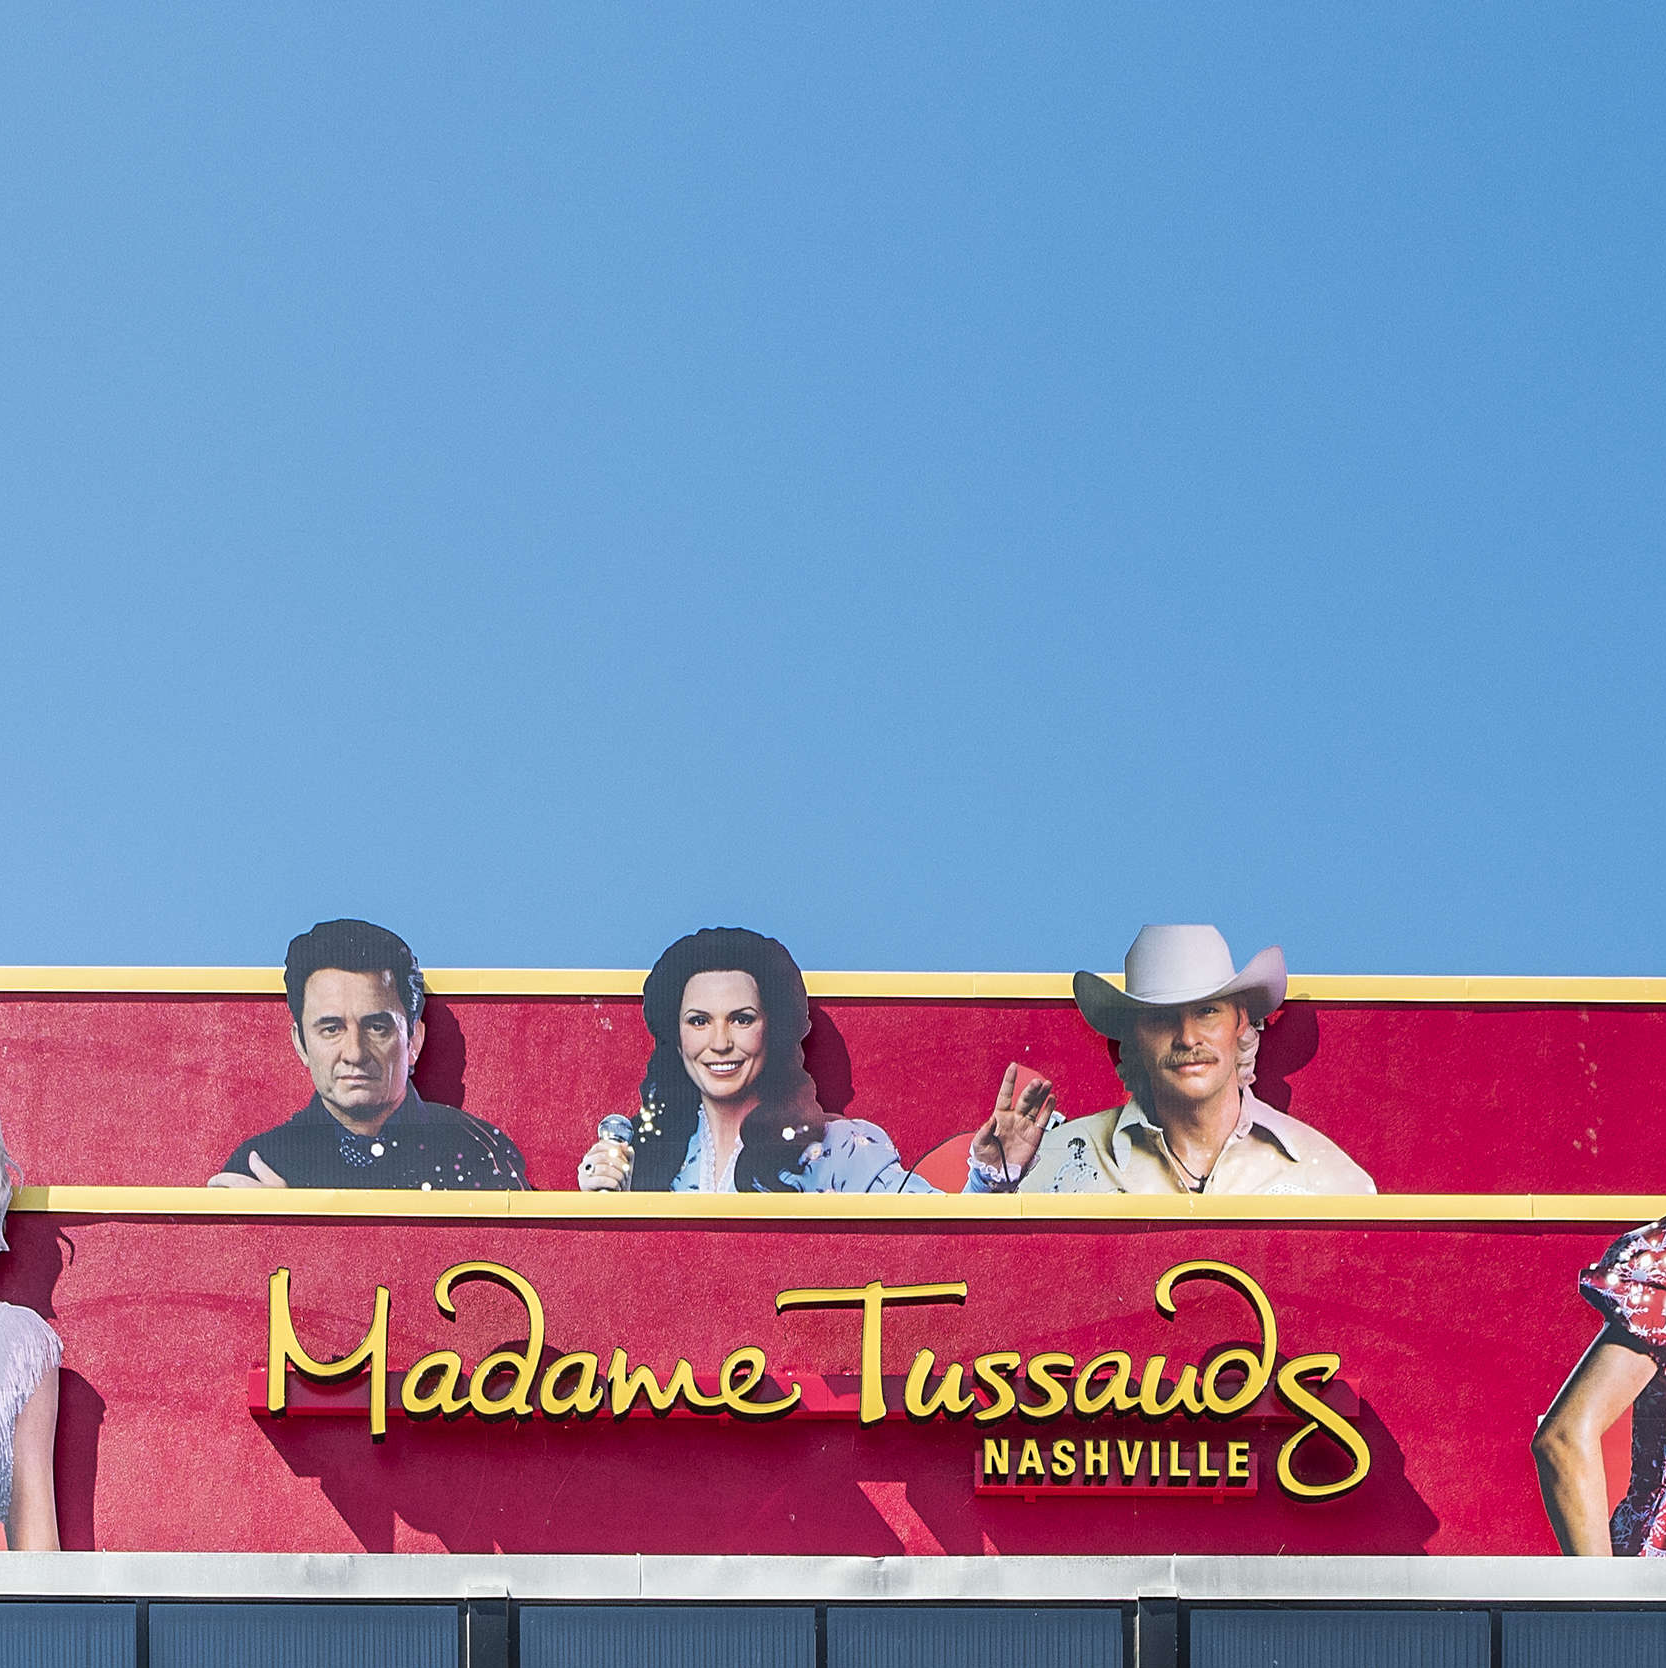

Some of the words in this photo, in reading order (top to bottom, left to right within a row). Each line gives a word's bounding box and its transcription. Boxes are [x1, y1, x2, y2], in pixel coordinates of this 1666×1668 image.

[268, 1260, 801, 1440] Madame
[775, 1259, 1371, 1502] Tussauds
[982, 1438, 1251, 1482] NASHVILLE
